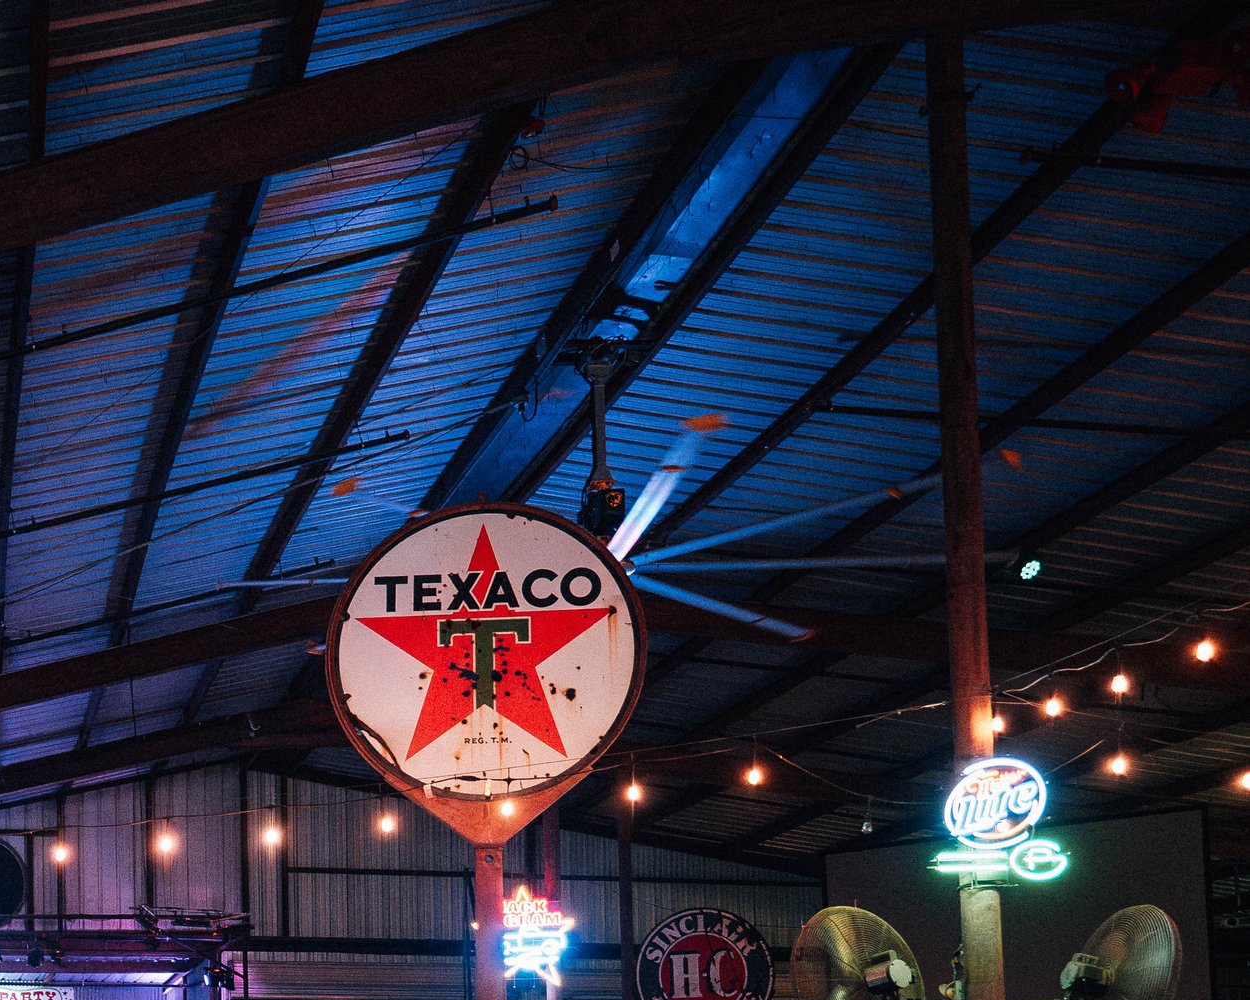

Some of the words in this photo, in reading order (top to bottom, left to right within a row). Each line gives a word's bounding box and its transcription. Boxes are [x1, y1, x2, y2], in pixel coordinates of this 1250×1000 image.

[374, 567, 602, 612] TEXACO
[437, 616, 532, 710] T
[464, 736, 488, 744] REG.
[503, 911, 562, 928] GRAM
[645, 914, 758, 964] SINCLAIR
